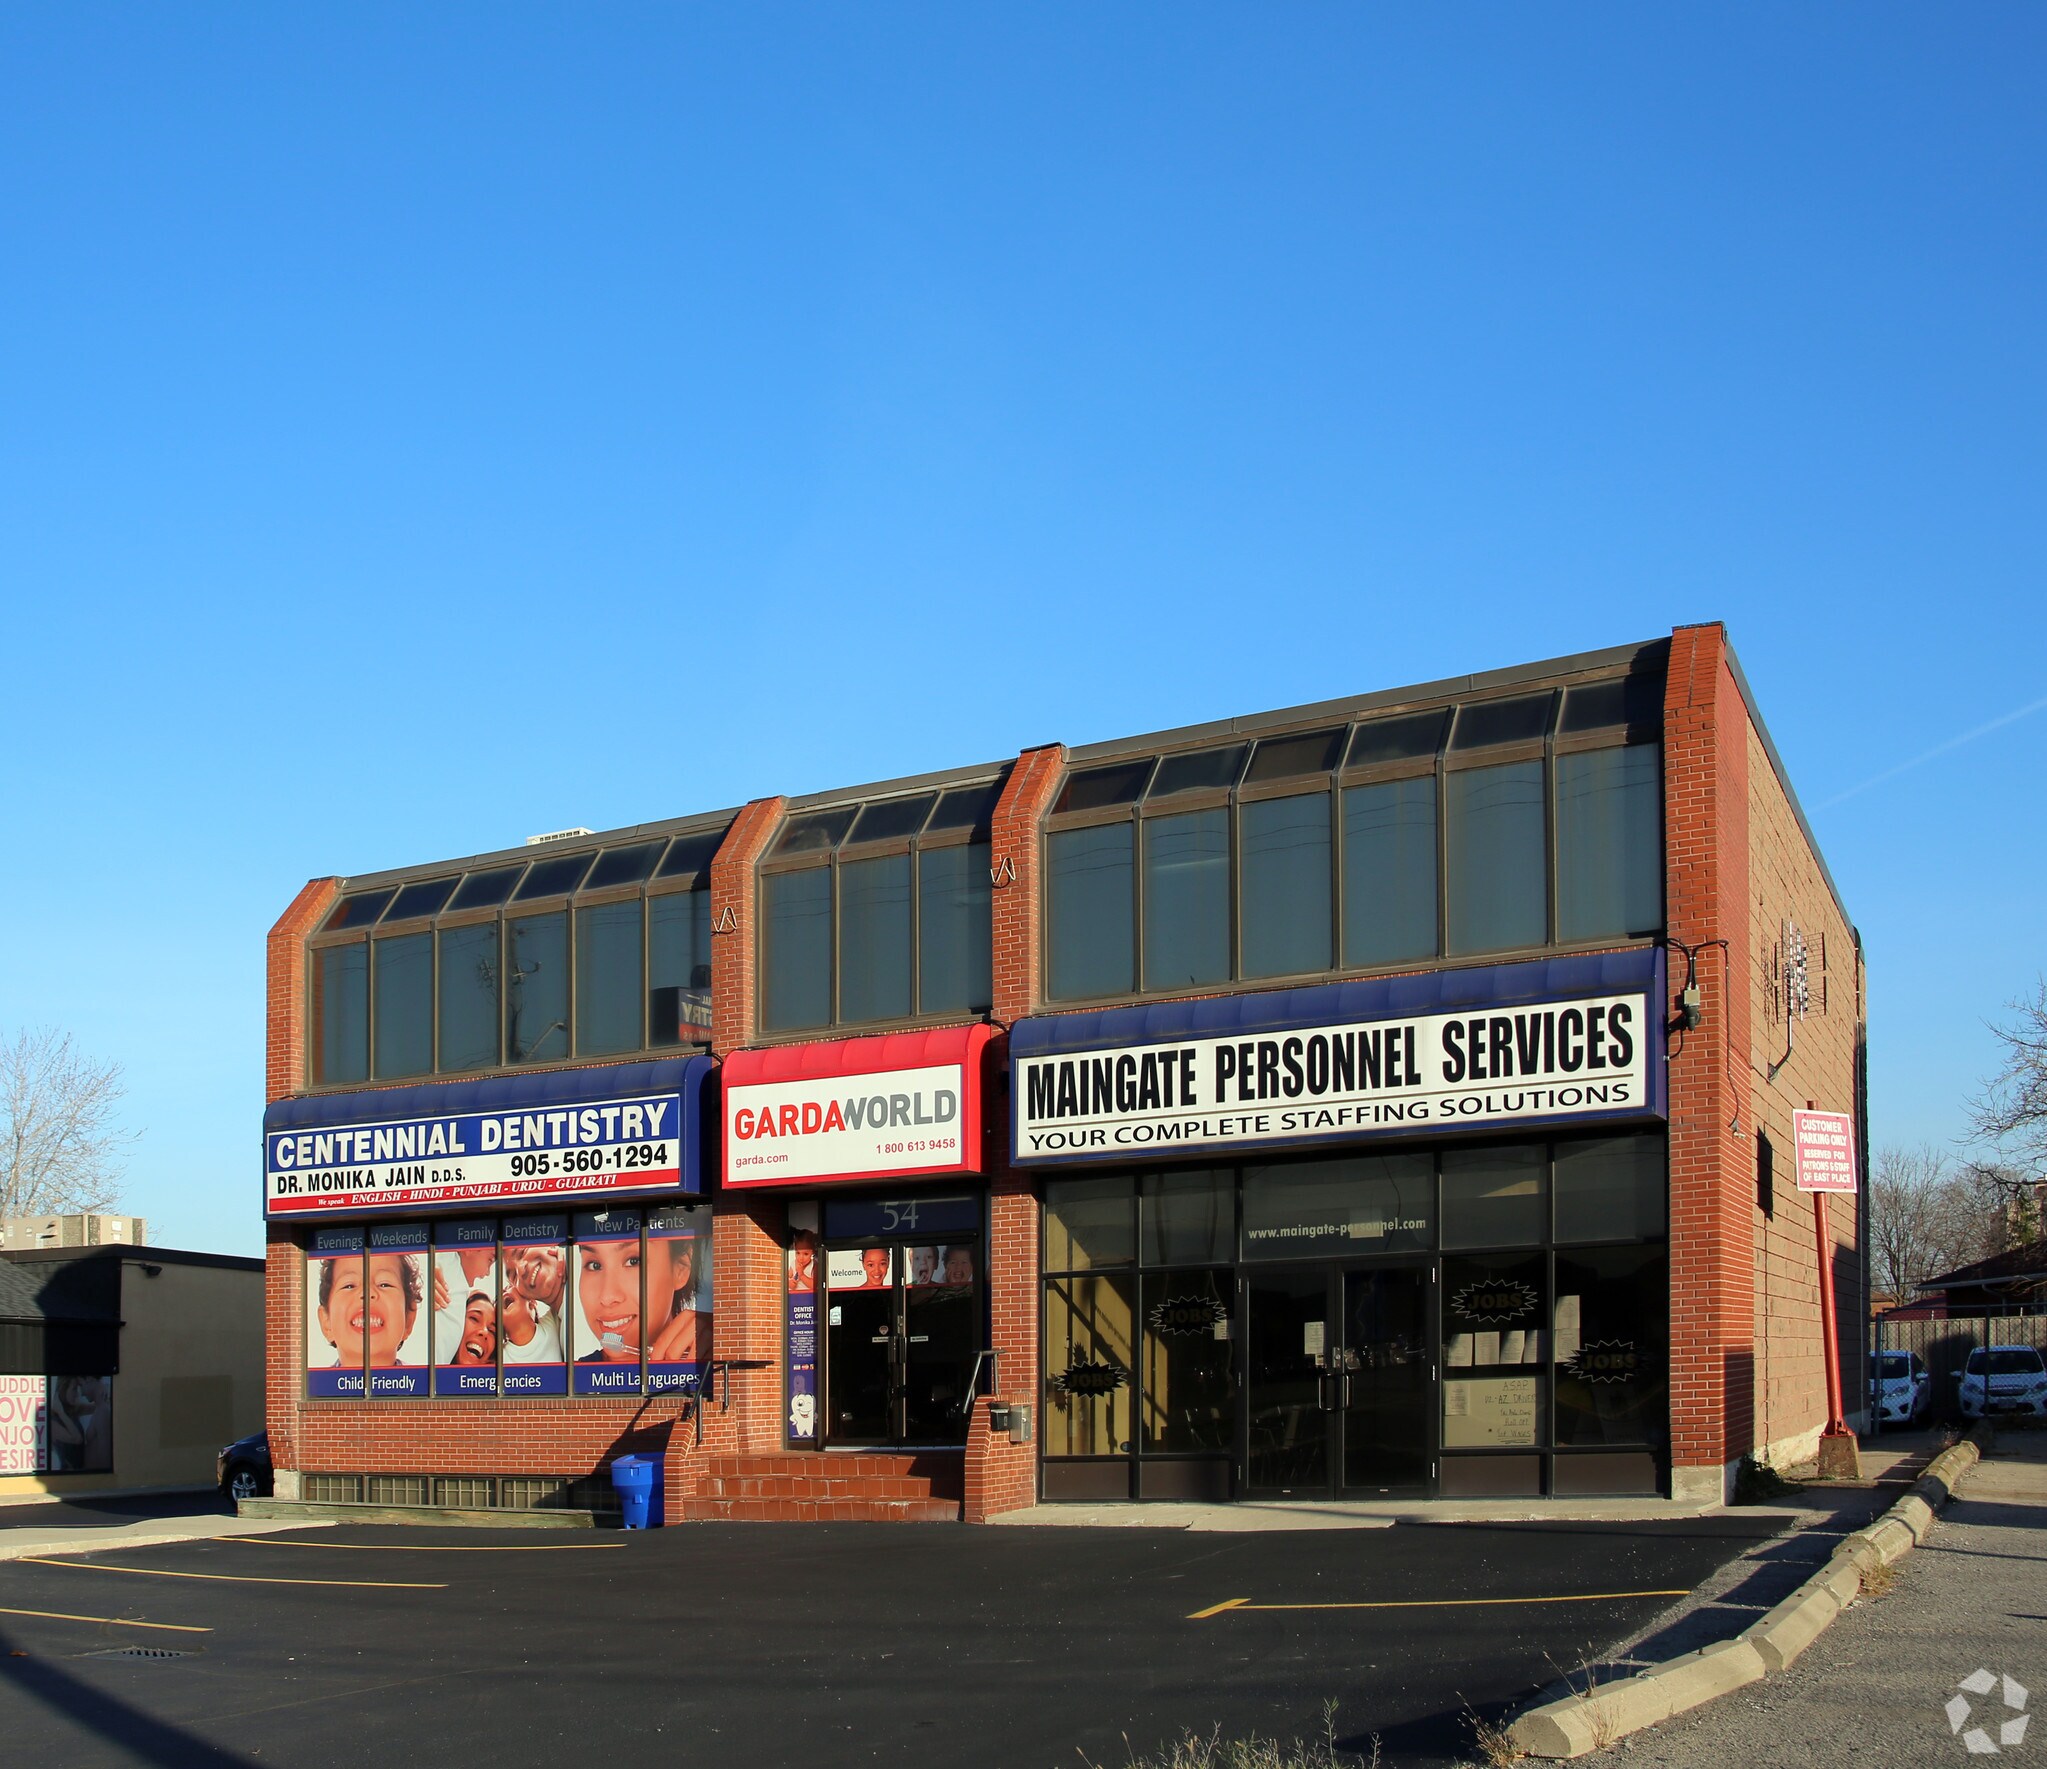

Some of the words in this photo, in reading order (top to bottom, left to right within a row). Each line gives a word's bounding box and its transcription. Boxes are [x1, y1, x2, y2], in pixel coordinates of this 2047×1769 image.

[1027, 1048, 1197, 1121] MAINGATE
[1215, 1026, 1421, 1103] PERSONNEL
[1441, 1003, 1633, 1083] SERVICES
[734, 1089, 957, 1140] GARDAWORLD
[1028, 1129, 1106, 1150] YOUR
[1114, 1115, 1270, 1143] COMPLETE
[1281, 1101, 1429, 1130] STAFFING
[1439, 1083, 1629, 1116] SOLUTIONS
[1801, 1118, 1843, 1133] CUSTOMER
[276, 1120, 465, 1169] CENTENNIAL
[481, 1102, 668, 1152] DENTISTRY
[1799, 1132, 1830, 1145] PARKING
[1831, 1134, 1847, 1146] ONLY
[876, 1144, 882, 1154] 1
[885, 1142, 904, 1153] 800
[907, 1141, 926, 1152] 613
[929, 1138, 956, 1150] 9458
[1804, 1149, 1831, 1159] RESERVED
[1833, 1151, 1846, 1160] FOR
[510, 1143, 667, 1177] 905-560-1294
[735, 1153, 788, 1168] garda.com
[277, 1175, 303, 1194] DR.
[307, 1168, 376, 1192] MONIKA
[385, 1165, 425, 1187] JAIN
[431, 1167, 466, 1184] D.D.S.
[1813, 1173, 1830, 1182] EAST
[1831, 1174, 1851, 1183] PLACE
[351, 1191, 402, 1204] ENGLISH
[409, 1188, 445, 1201] HINDI
[452, 1184, 502, 1196] PUNJABI
[511, 1180, 547, 1192] URDU
[556, 1175, 616, 1189] GUJARATI
[882, 1199, 919, 1230] 54
[458, 1226, 495, 1242] Family
[505, 1222, 559, 1238] Dentistry
[1248, 1217, 1426, 1239] www.maingate-personnel.com
[317, 1235, 363, 1250] Evenings
[371, 1230, 428, 1246] Weekends
[831, 1268, 863, 1278] Welcome
[1469, 1292, 1523, 1309] JOBS
[1581, 1353, 1637, 1370] JOBS
[337, 1375, 364, 1391] Child
[371, 1374, 416, 1393] Friendly
[591, 1371, 624, 1388] Multi
